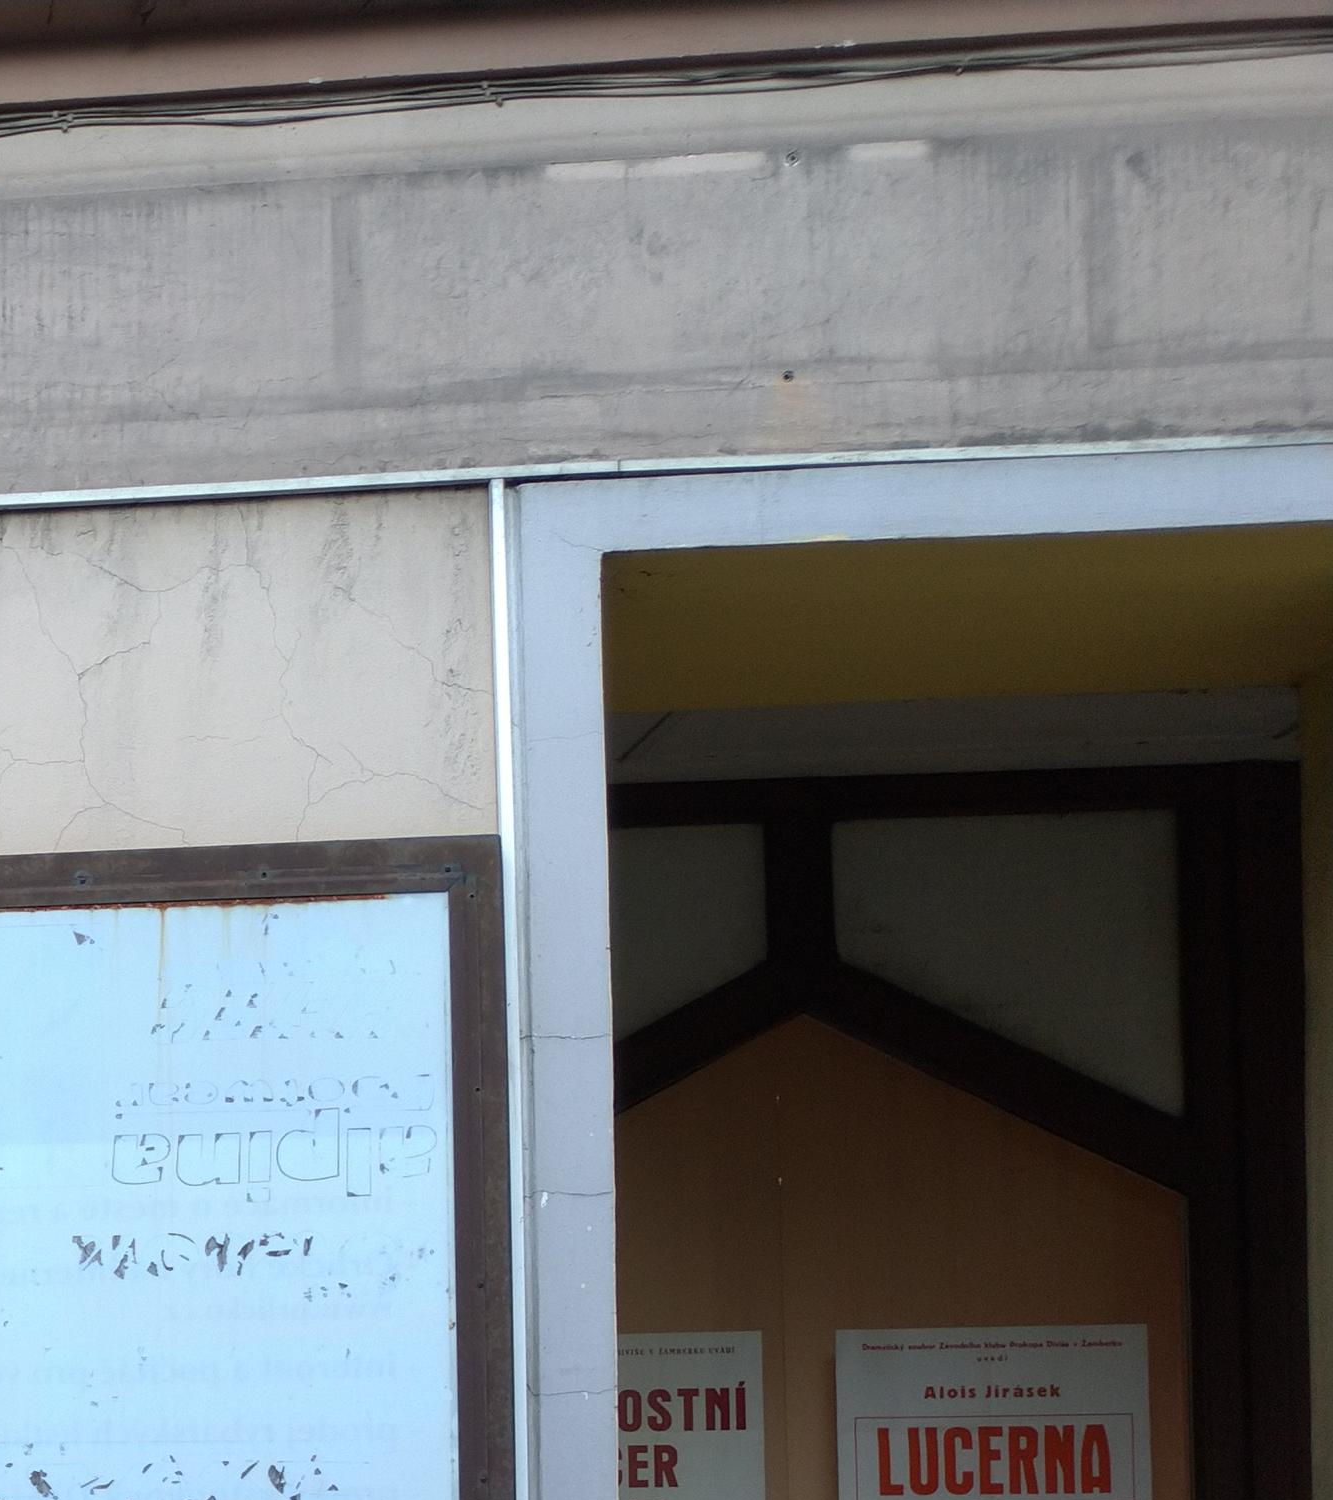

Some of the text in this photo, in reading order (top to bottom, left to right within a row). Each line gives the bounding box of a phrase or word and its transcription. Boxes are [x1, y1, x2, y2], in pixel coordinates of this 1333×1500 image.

[618, 1381, 747, 1432] OSTNÍ
[923, 1383, 1061, 1400] Alois Jirásek
[618, 1444, 679, 1488] ER
[876, 1423, 1112, 1497] LUCERNA
